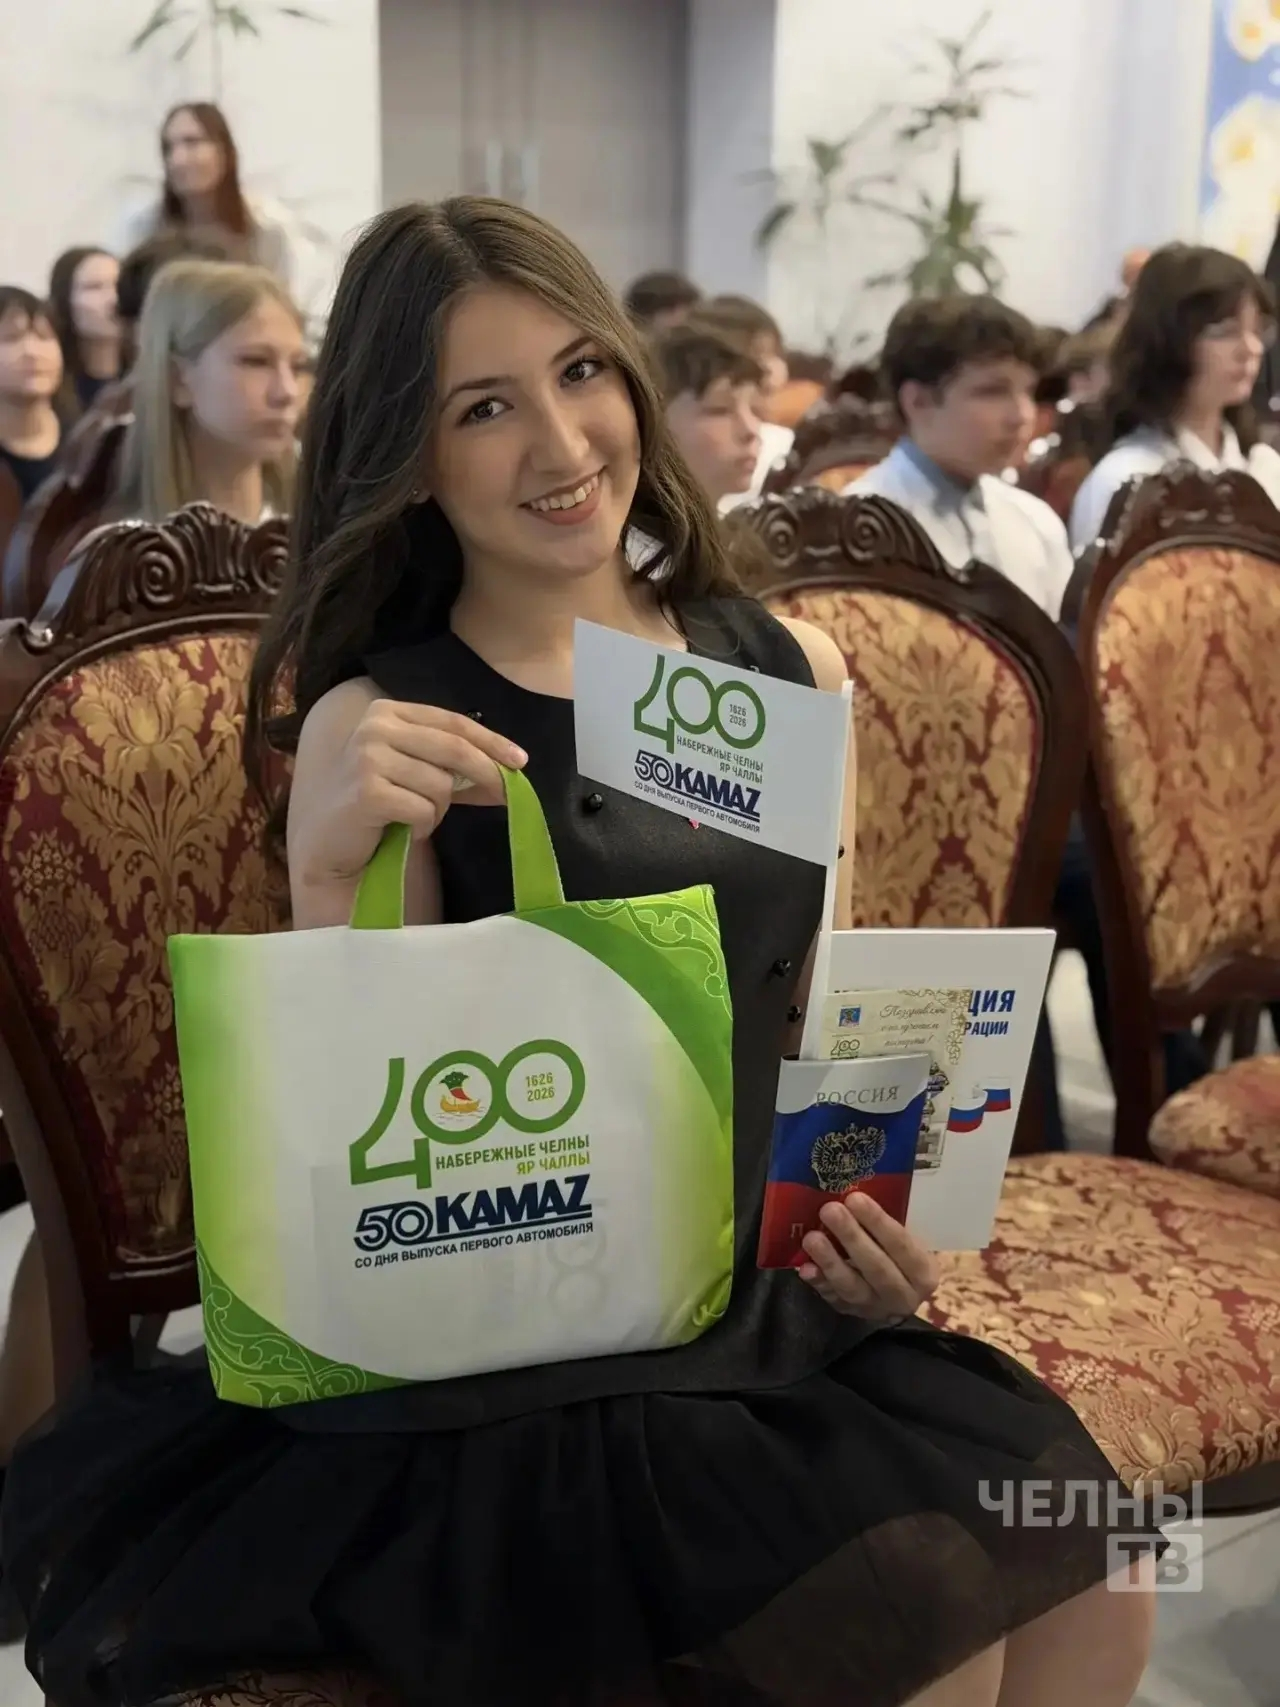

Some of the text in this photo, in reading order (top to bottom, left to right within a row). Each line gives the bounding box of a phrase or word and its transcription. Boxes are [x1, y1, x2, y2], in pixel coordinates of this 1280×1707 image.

[634, 654, 766, 754] 400
[729, 704, 747, 717] 1626
[729, 715, 747, 727] 2026
[676, 735, 764, 772] НАБЕРЕЖНЫЕ ЧЕЛНЫ
[719, 762, 763, 784] ЯР ЧАЛЛЫ
[634, 781, 761, 833] СО ДНЯ ВЫПУСКА ПЕРВОГО АВТОМОБИЛЯ
[962, 1021, 1009, 1037] РАЦИИ
[526, 1072, 554, 1088] 1626
[527, 1087, 555, 1102] 2026
[815, 1085, 900, 1107] РОССИЯ
[349, 1039, 586, 1190] 400
[436, 1135, 590, 1170] НАБЕРЕЖНЫЕ ЧЕЛНЫ
[516, 1152, 590, 1175] ЯР ЧАЛЛЫ
[355, 1222, 594, 1269] СО ДНЯ ВЫПУСКА ПЕРВОГО АВТОМОБИЛЯ
